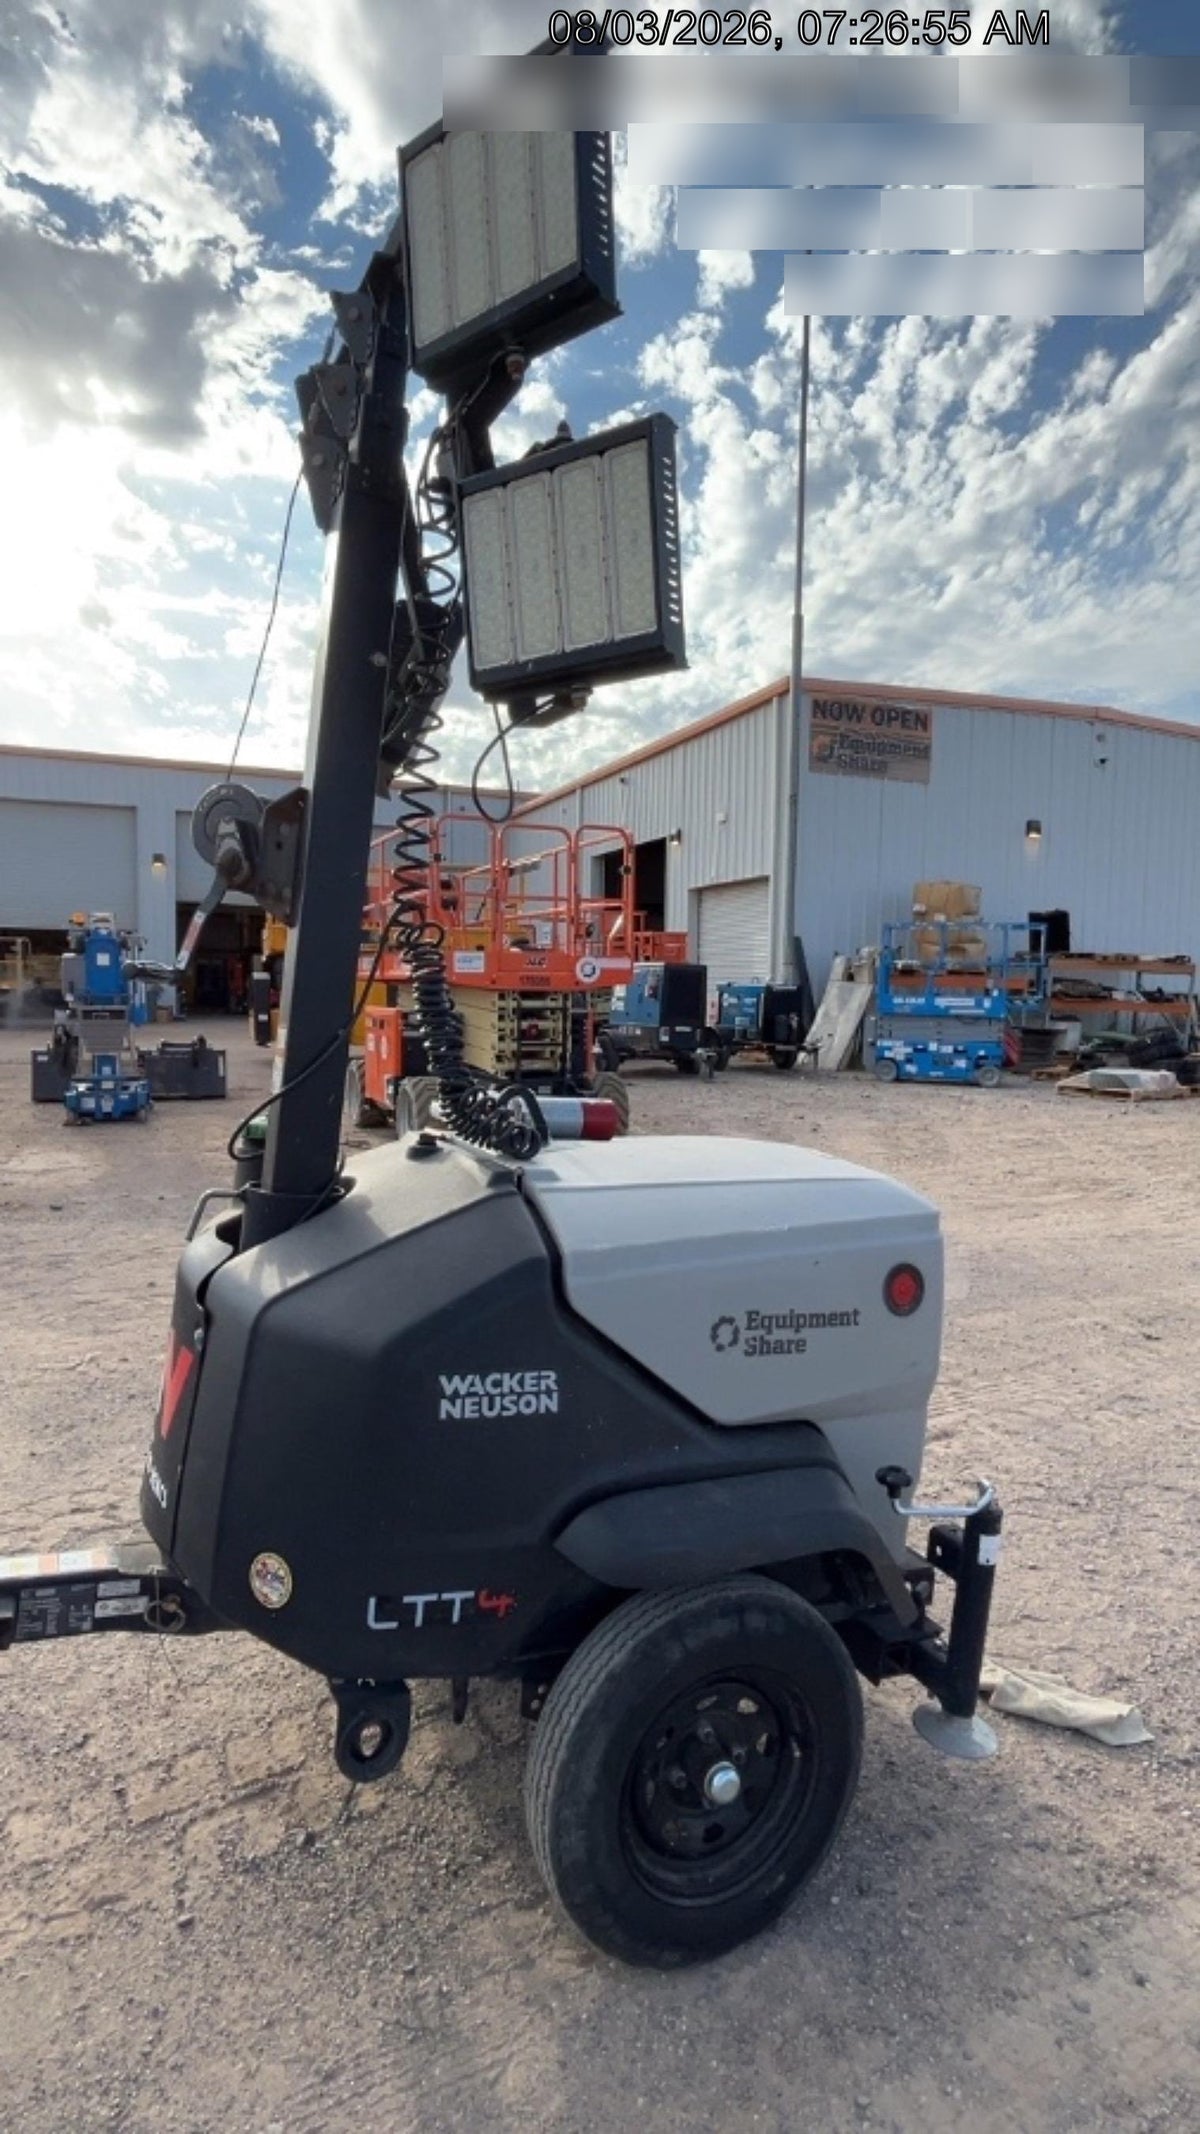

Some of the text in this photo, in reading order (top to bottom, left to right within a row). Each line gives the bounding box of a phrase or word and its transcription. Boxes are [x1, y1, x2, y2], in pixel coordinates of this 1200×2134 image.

[813, 699, 928, 733] NOW OPEN
[744, 1308, 860, 1335] Equipment
[744, 1335, 807, 1357] Share
[439, 1370, 558, 1396] WACKER
[439, 1391, 558, 1420] NEUSON
